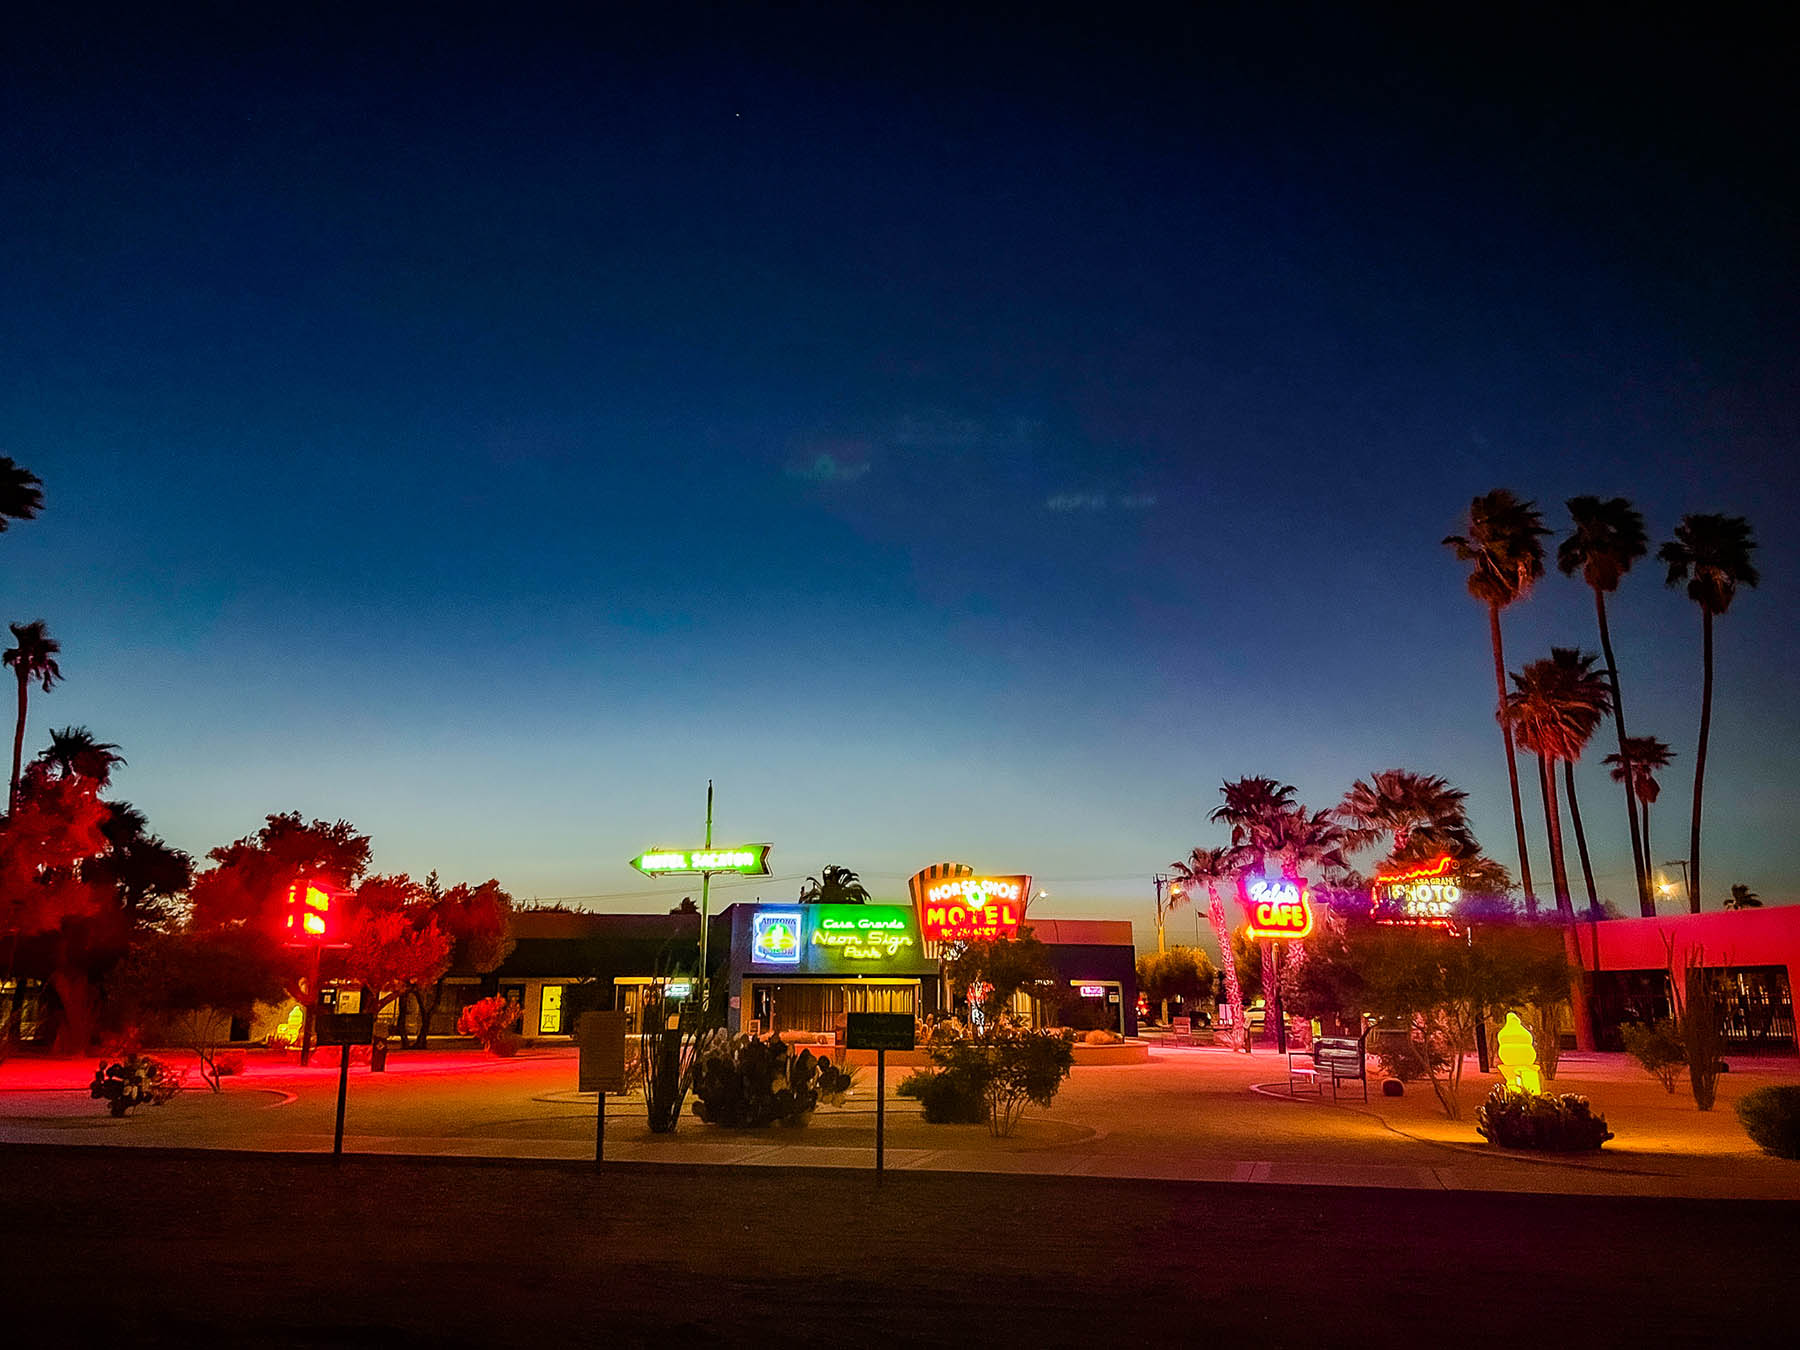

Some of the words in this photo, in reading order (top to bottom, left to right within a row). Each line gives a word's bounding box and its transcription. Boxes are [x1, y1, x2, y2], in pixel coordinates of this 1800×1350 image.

[822, 919, 856, 929] Casa
[858, 919, 905, 929] Grande
[927, 905, 1017, 926] MOTEL
[1257, 903, 1304, 927] CAFE
[812, 931, 863, 945] Neon
[867, 931, 913, 956] Sign
[844, 945, 882, 959] Park
